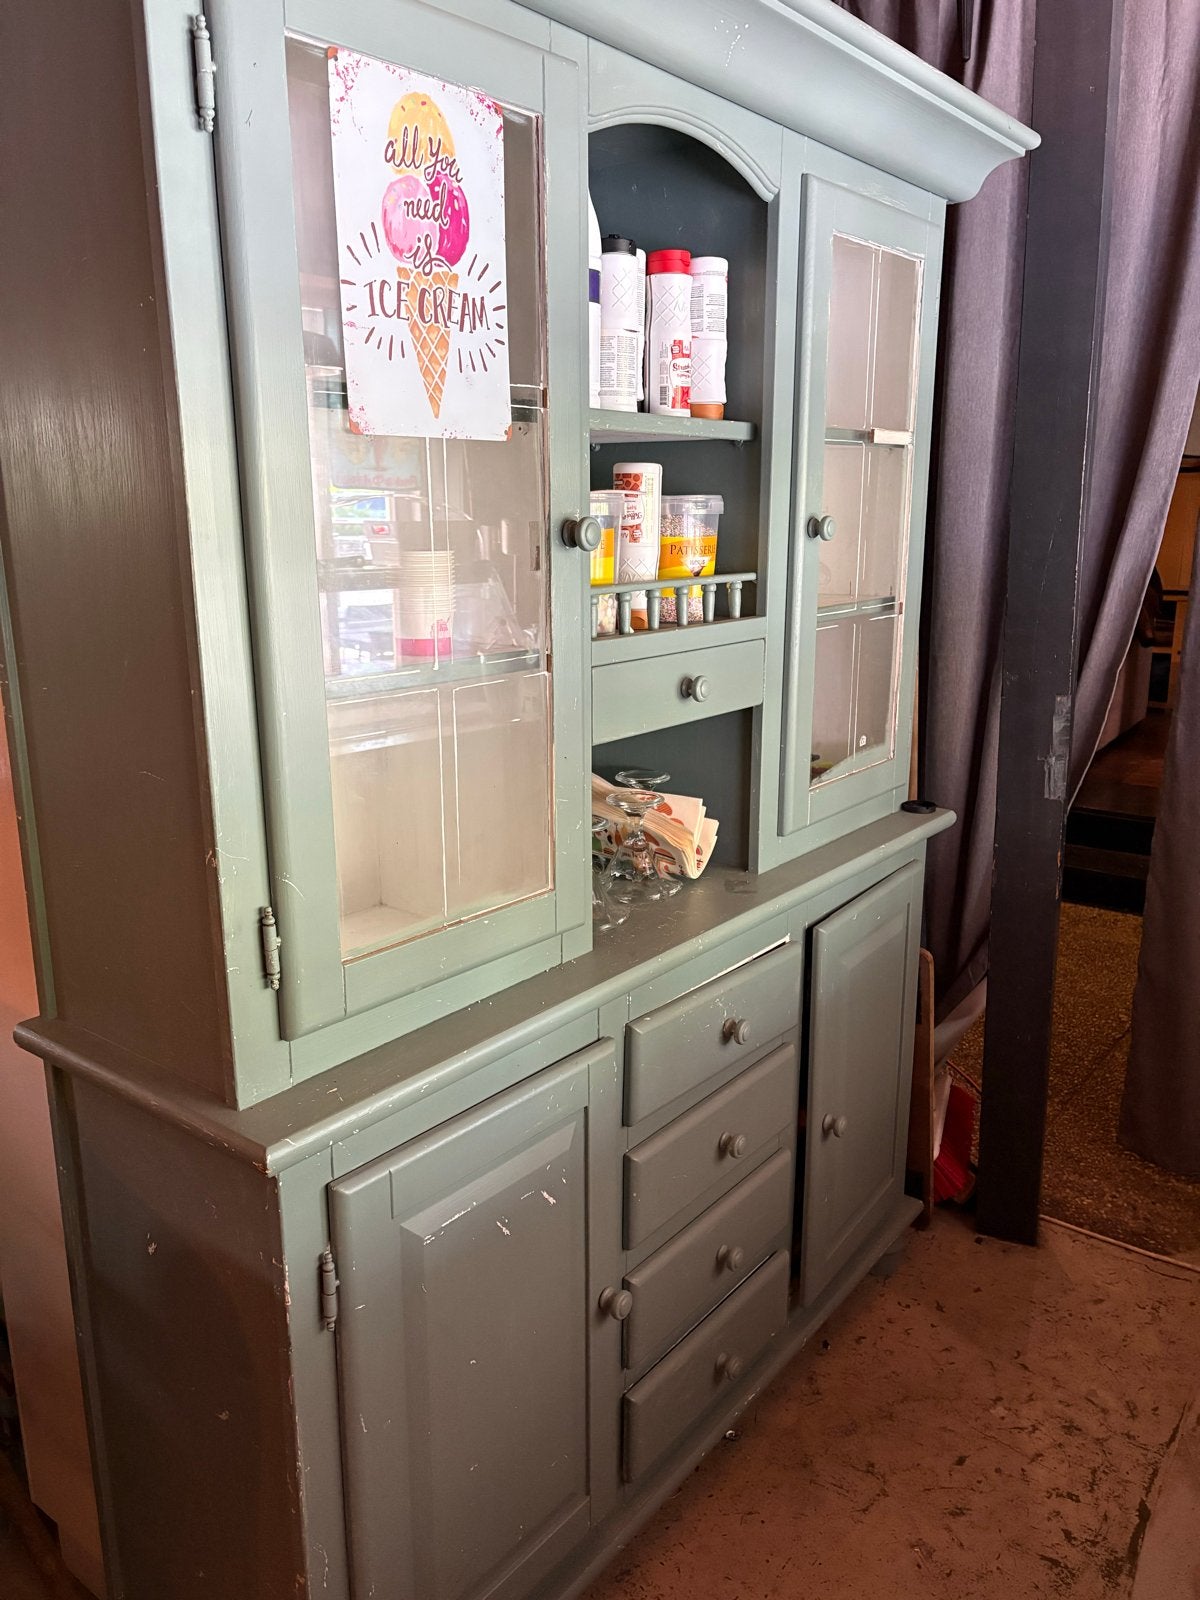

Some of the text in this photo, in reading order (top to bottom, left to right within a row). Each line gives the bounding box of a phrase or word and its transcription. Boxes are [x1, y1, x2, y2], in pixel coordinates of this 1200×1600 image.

[384, 125, 423, 169] all
[403, 182, 449, 227] need
[404, 233, 453, 276] is
[363, 279, 490, 334] ICE CREAM
